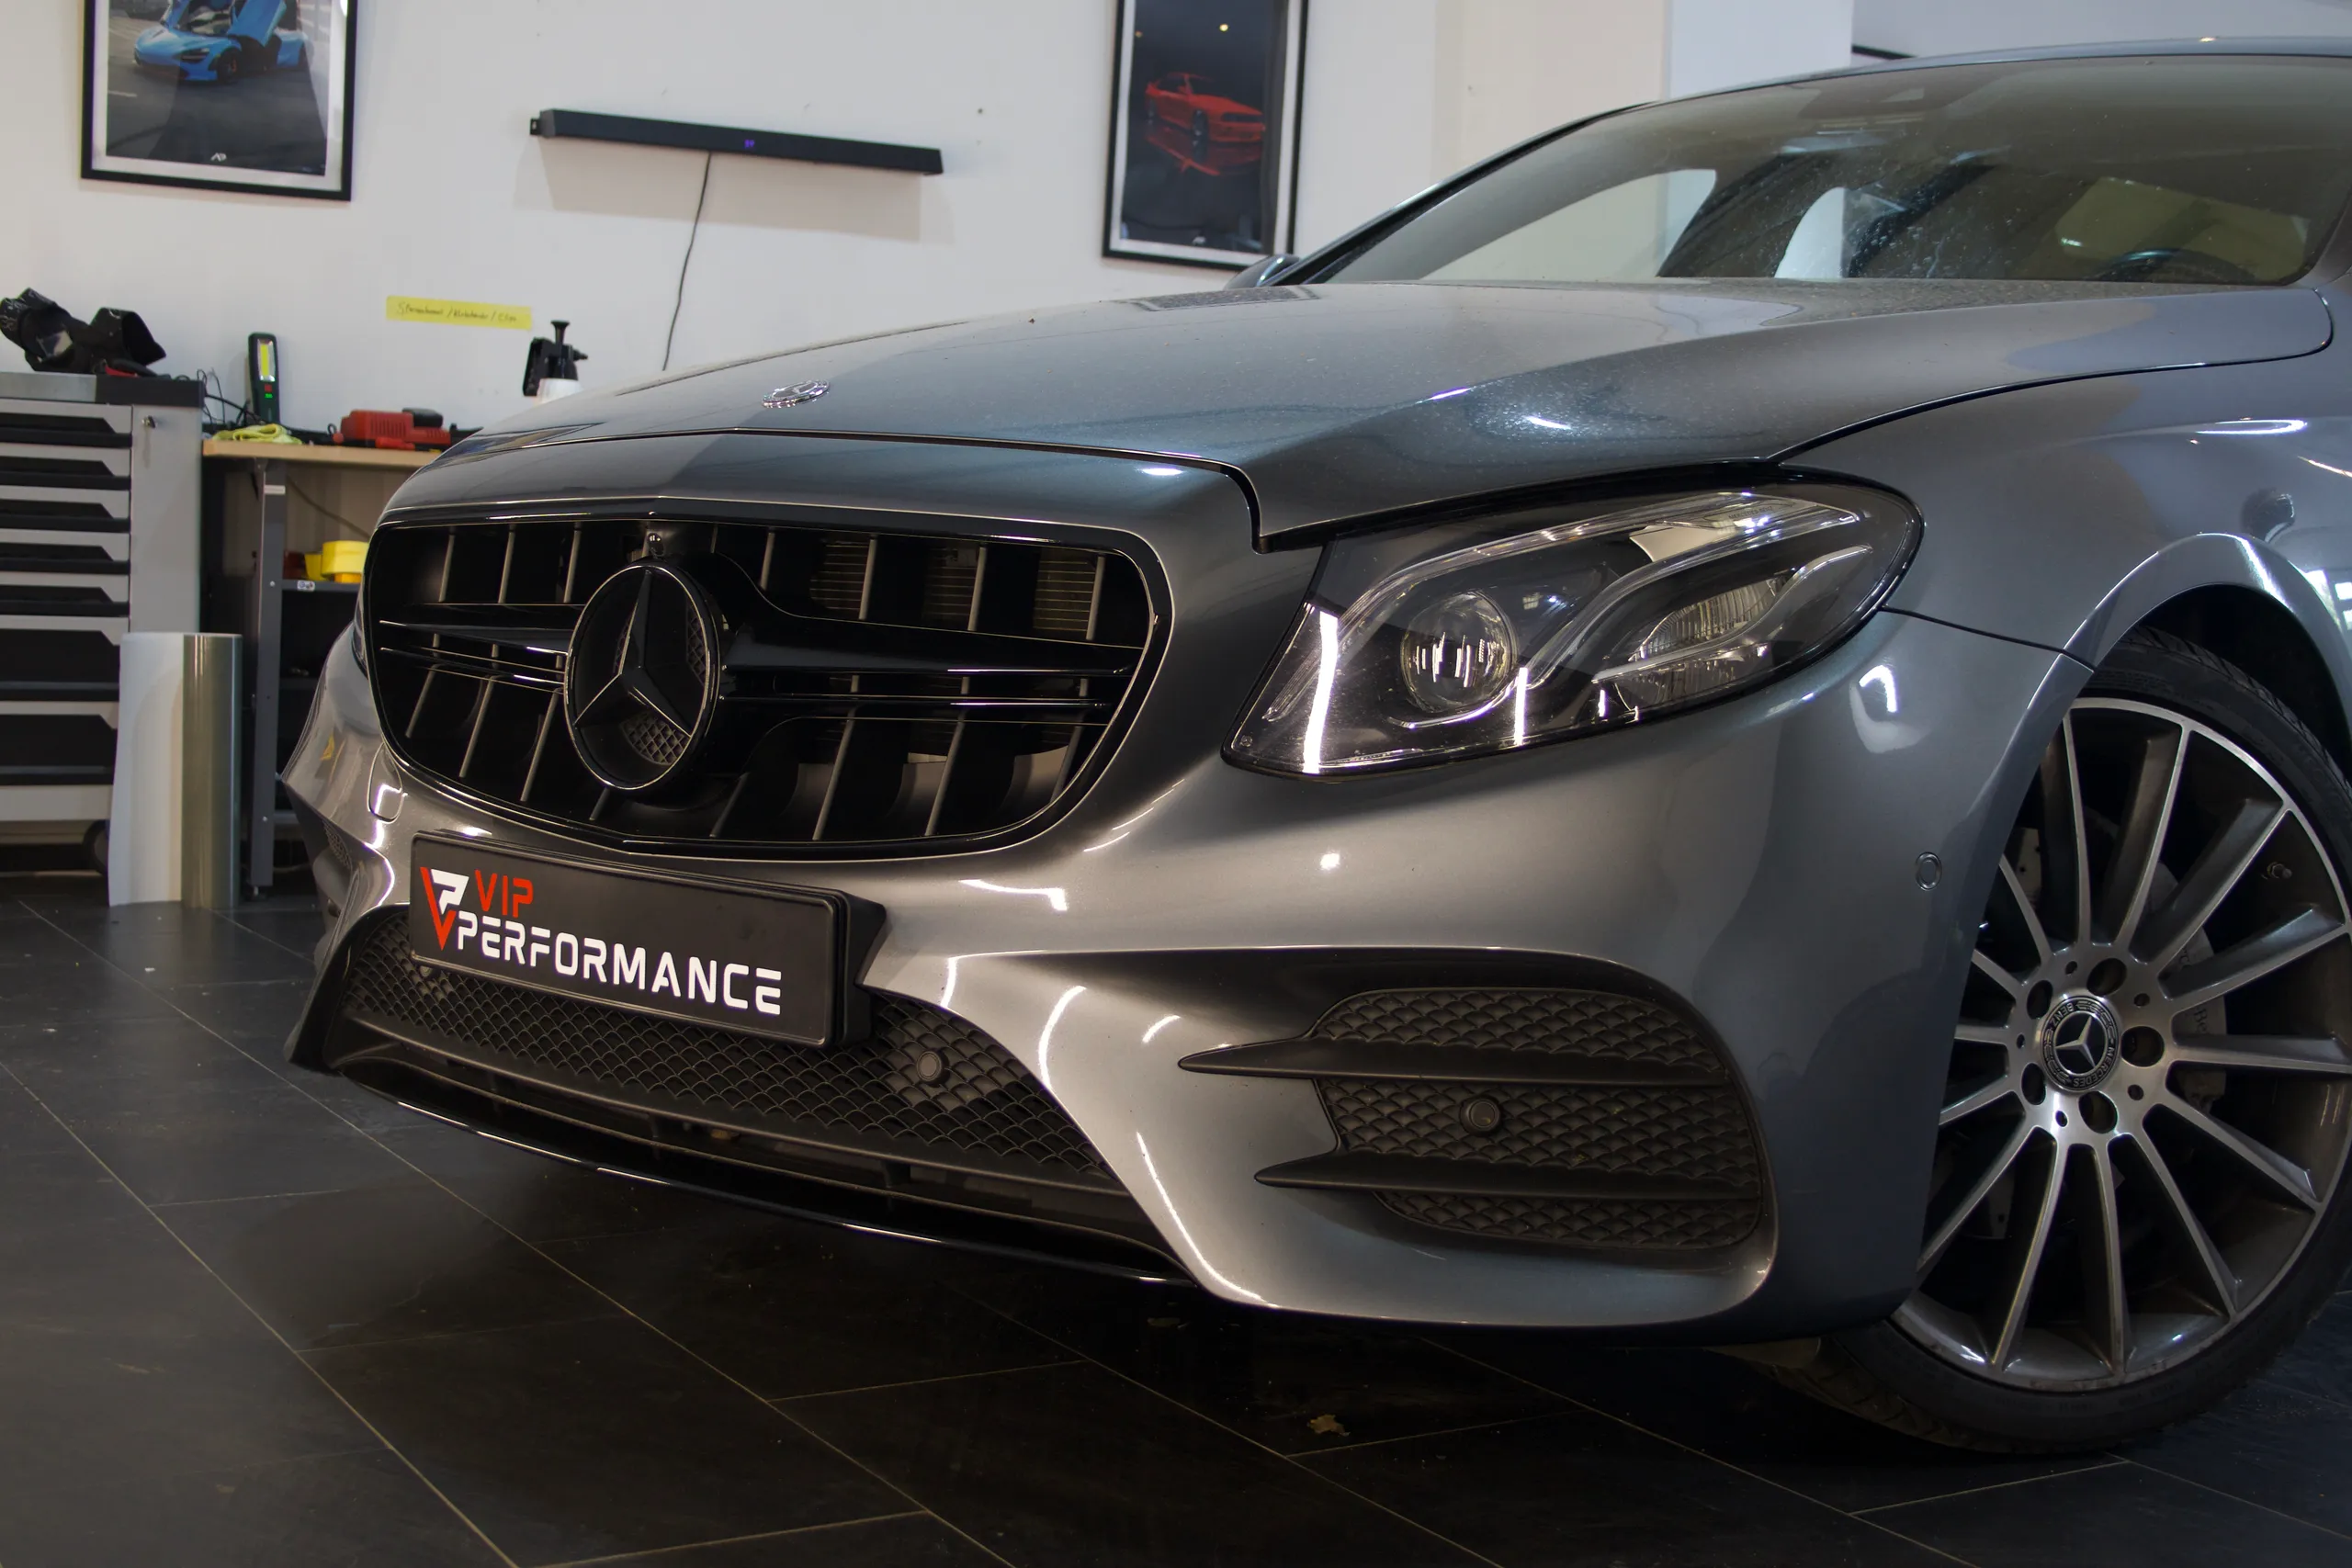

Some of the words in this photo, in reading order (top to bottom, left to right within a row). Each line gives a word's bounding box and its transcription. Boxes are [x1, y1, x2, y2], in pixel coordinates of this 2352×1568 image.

[474, 869, 534, 918] VIP
[457, 910, 782, 1015] PERFORMANCE
[2051, 1002, 2075, 1028] BENZ
[2073, 1046, 2116, 1088] MERCEDES
